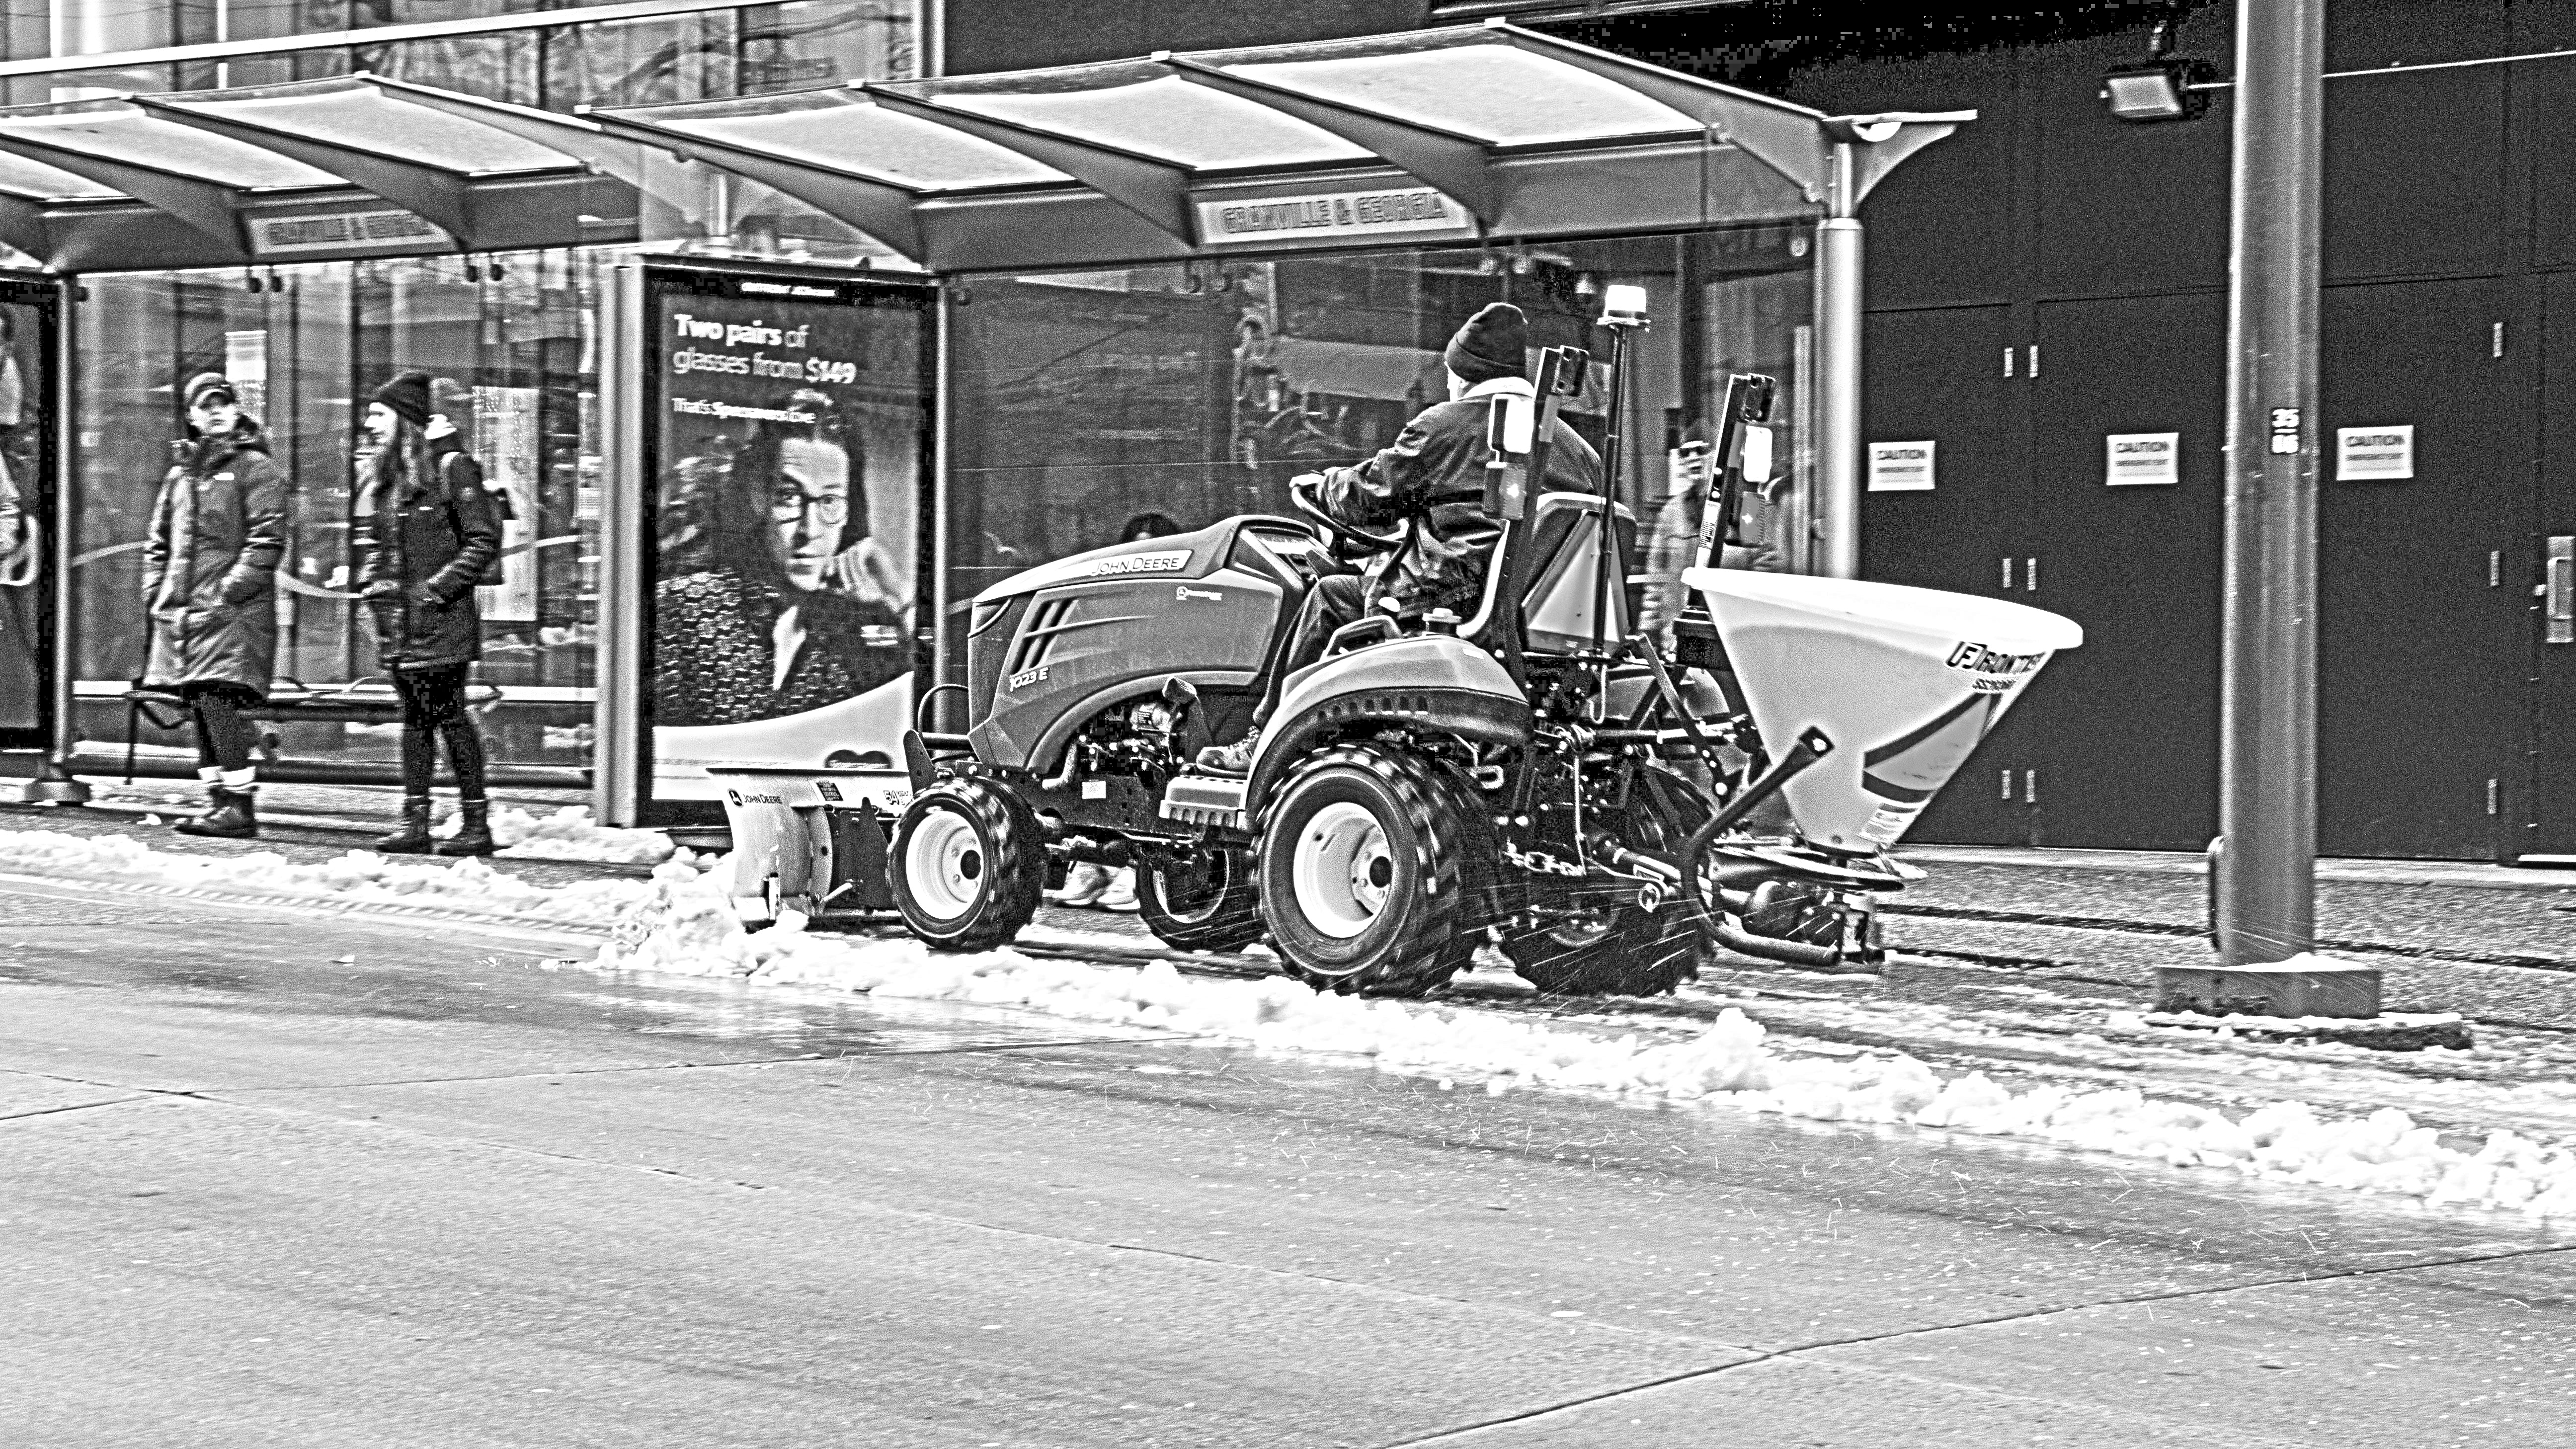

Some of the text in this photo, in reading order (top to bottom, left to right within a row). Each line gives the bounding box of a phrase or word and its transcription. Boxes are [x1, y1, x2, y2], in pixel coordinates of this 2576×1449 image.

[674, 314, 810, 348] Two pairs of
[672, 346, 857, 384] glasses from $149
[2272, 408, 2299, 427] 35
[2114, 441, 2171, 453] CAUTION
[2344, 435, 2405, 447] CAUTION
[1876, 449, 1927, 460] CAUTION
[1092, 558, 1180, 574] JOHN DEERE
[743, 794, 783, 805] JOHN DEERE
